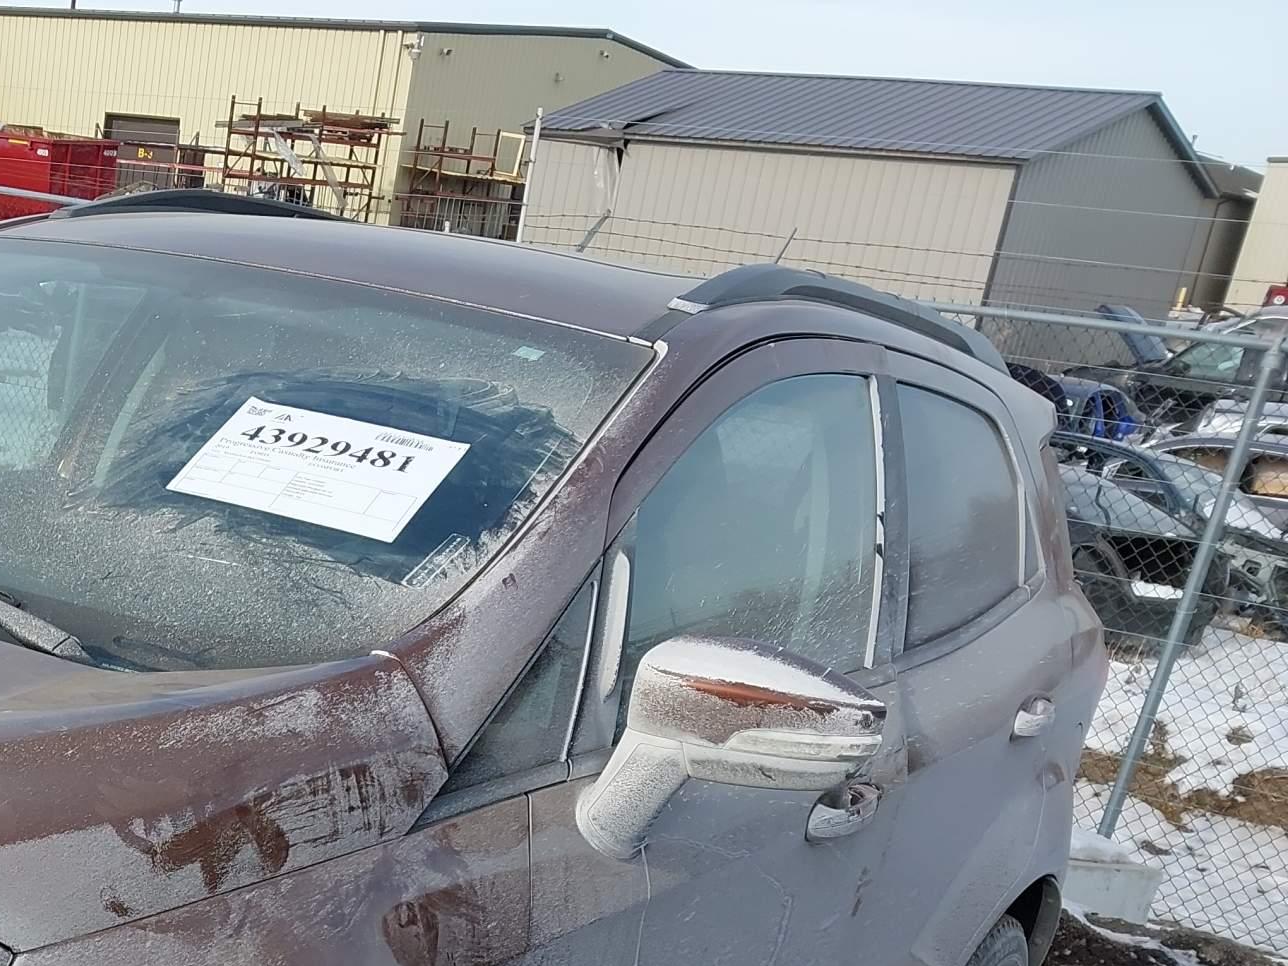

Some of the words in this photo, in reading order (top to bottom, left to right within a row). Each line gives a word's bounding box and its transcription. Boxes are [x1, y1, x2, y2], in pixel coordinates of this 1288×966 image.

[219, 437, 270, 452] Progressive
[271, 446, 311, 461] Casualty
[312, 455, 357, 469] Insurance
[240, 425, 416, 474] 43929481
